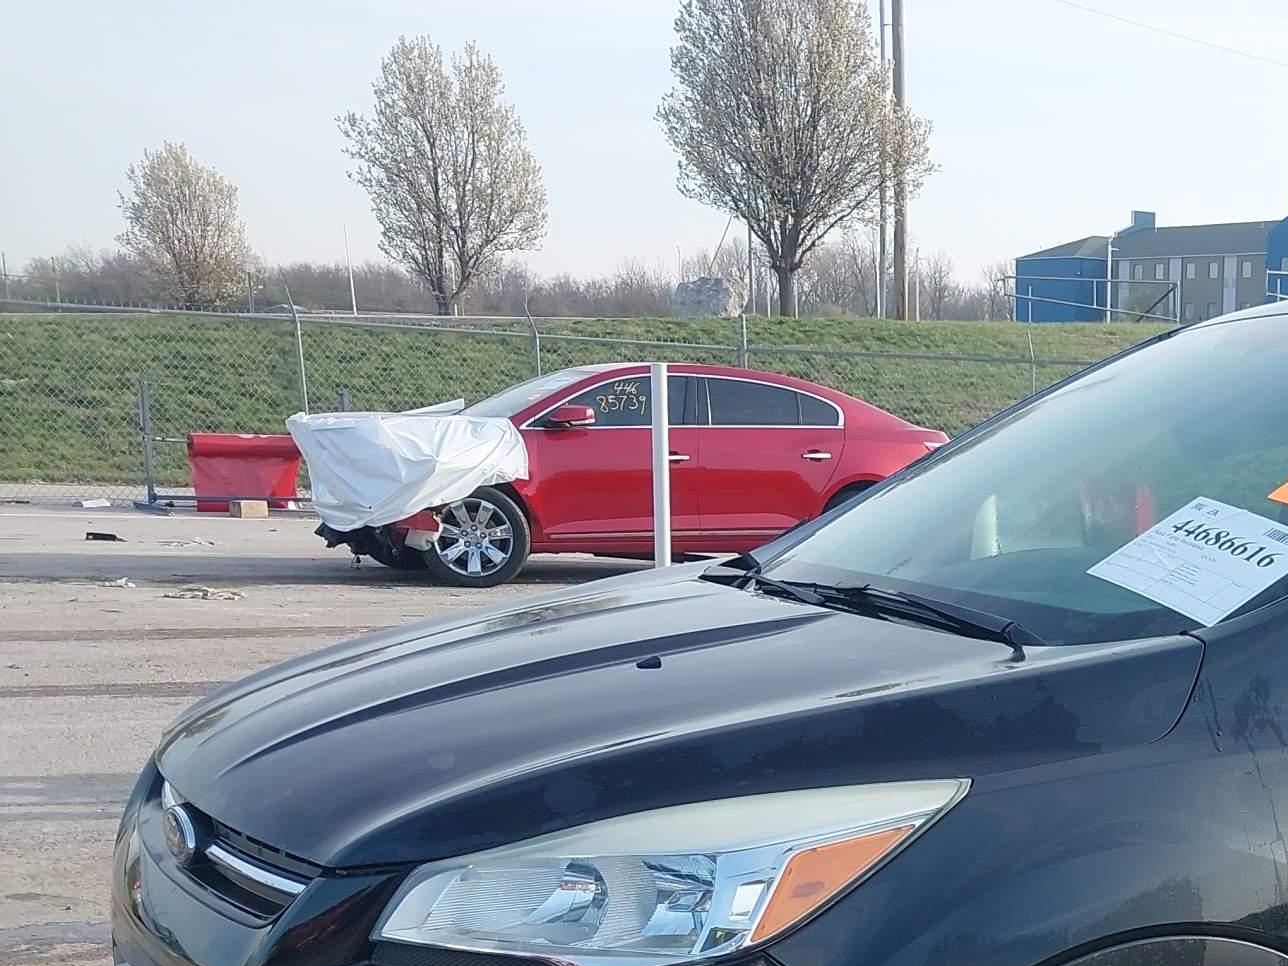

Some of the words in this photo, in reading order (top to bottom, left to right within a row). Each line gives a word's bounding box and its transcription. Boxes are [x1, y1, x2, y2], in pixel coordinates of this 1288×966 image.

[613, 382, 640, 395] 446
[595, 394, 647, 416] 85739
[1171, 519, 1286, 569] 44686616
